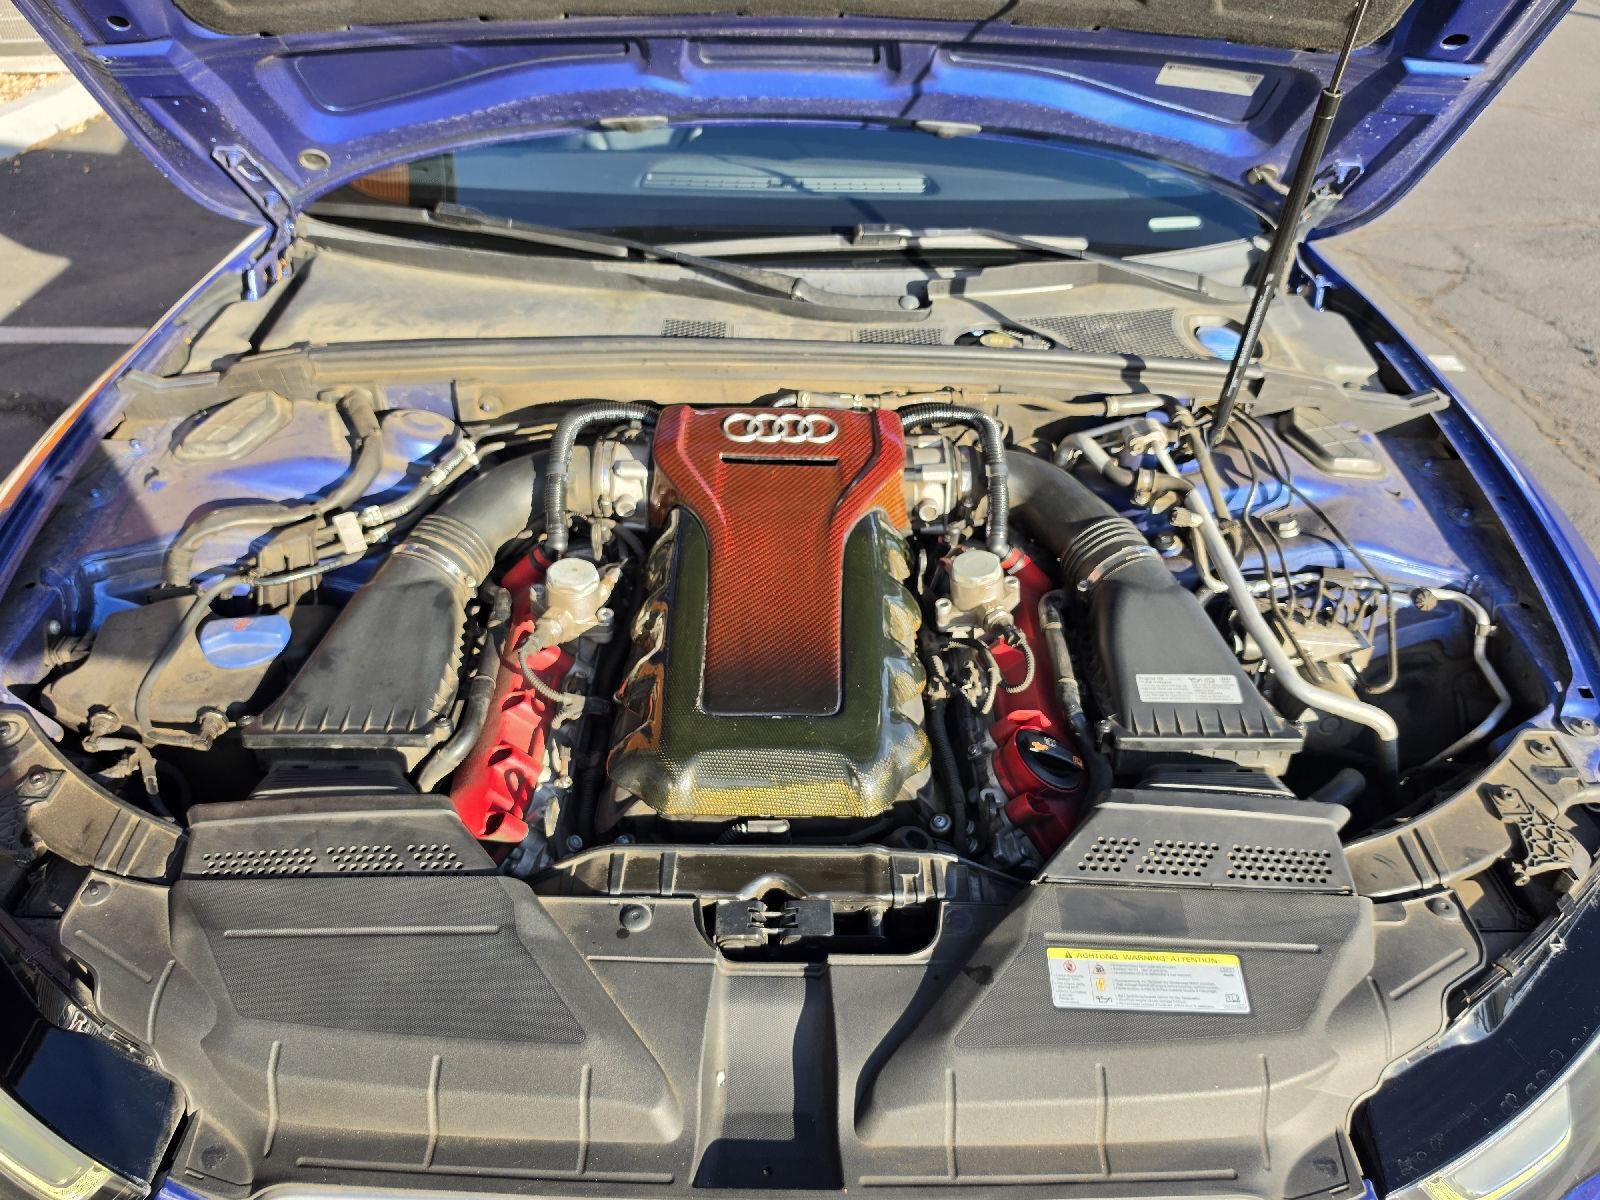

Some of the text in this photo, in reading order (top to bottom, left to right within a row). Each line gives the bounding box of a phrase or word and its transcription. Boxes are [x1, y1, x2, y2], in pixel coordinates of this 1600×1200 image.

[1076, 952, 1218, 964] ACHTUNG WARNING ATTENTION
